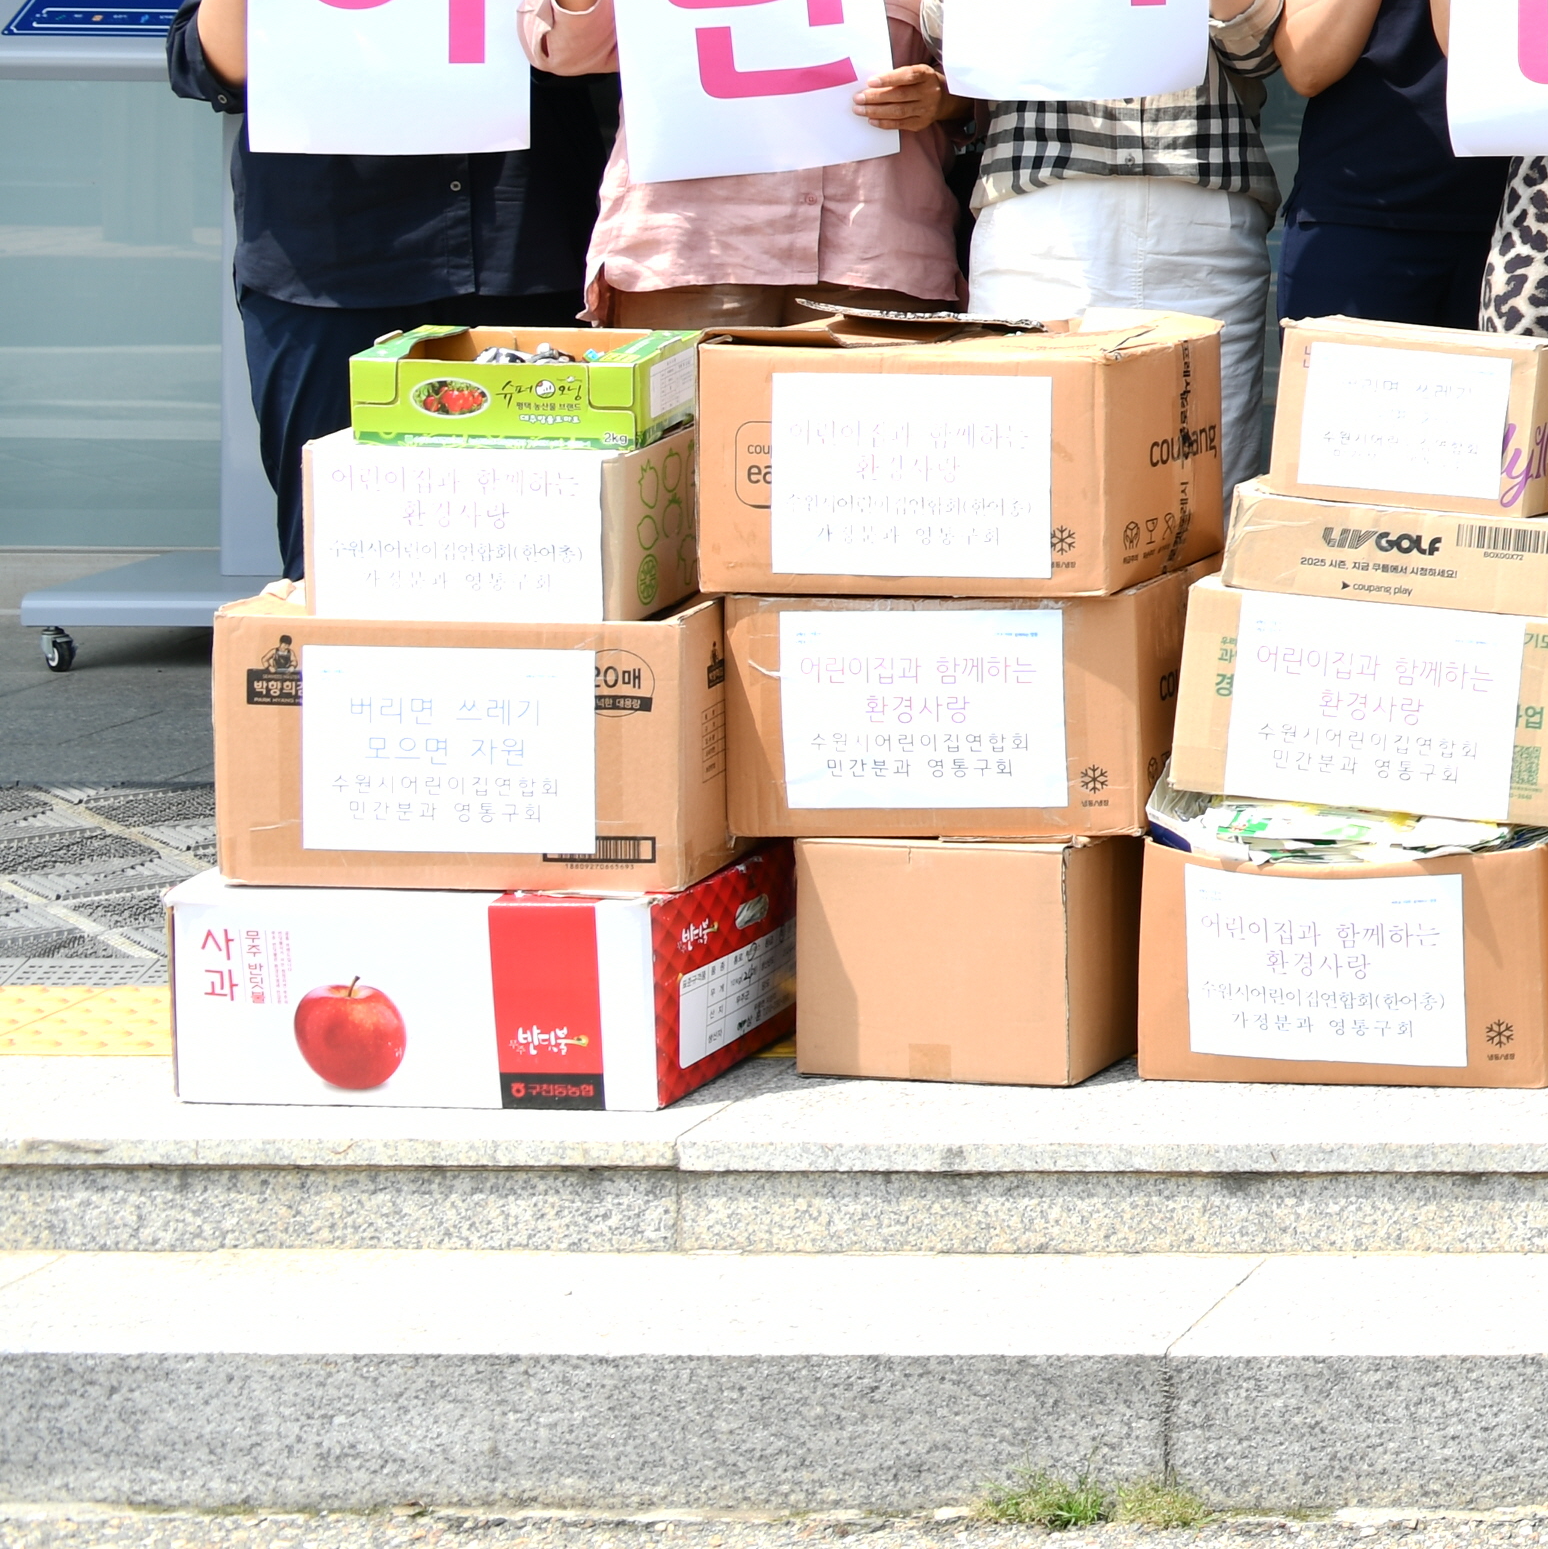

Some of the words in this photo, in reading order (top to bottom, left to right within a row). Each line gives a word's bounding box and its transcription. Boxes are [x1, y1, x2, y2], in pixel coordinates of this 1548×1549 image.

[558, 401, 581, 411] 브랜드
[603, 432, 628, 446] 2kg
[1375, 531, 1442, 556] GOLF
[1300, 557, 1326, 568] 2025
[1352, 561, 1370, 572] 지금
[1352, 582, 1391, 596] coupang
[1393, 585, 1413, 597] play
[800, 656, 921, 684] 어린이집과
[935, 656, 1037, 684] 함께하는
[865, 695, 970, 724] 환경사랑
[811, 732, 1029, 753] 수원시어린이집연합회
[827, 757, 911, 777] 민간분과
[927, 757, 1013, 777] 영통구회
[245, 930, 262, 957] 무주
[201, 928, 239, 1002] 사과
